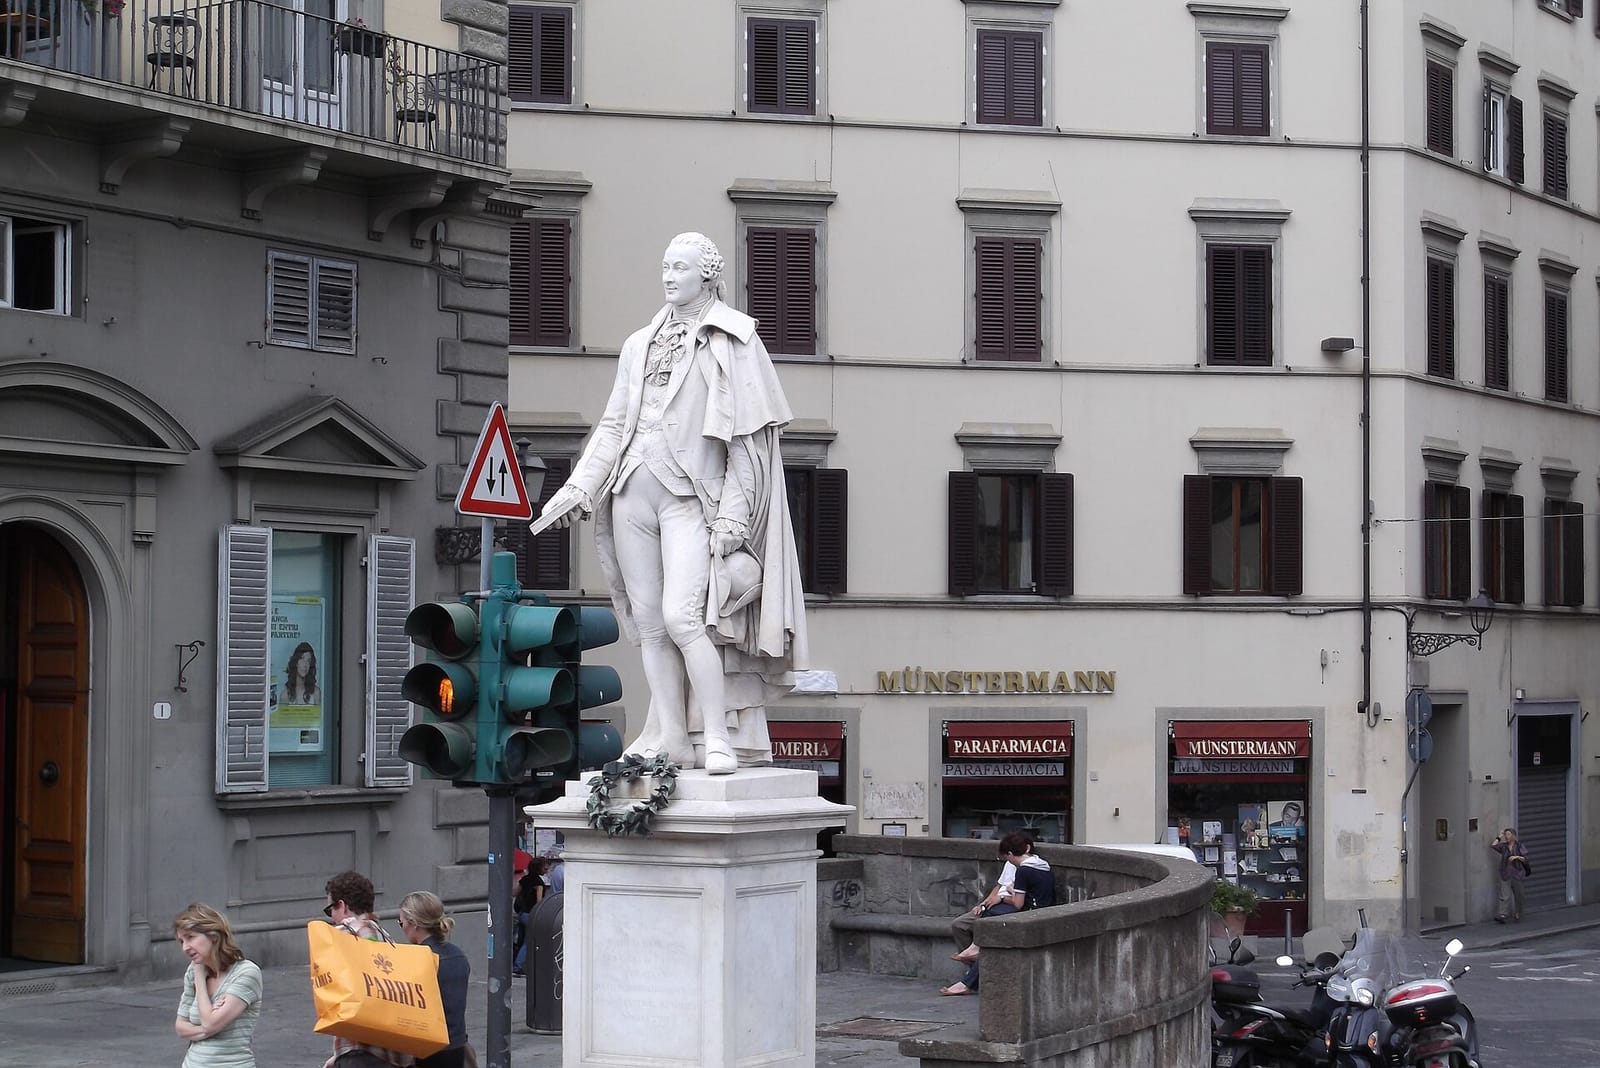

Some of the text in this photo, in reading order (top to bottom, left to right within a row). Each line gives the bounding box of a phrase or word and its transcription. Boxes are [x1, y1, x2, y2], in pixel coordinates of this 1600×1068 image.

[877, 665, 1117, 693] MÜNSTERMANN
[953, 739, 1067, 753] PARAFARMACIA
[945, 763, 1060, 776] PARAFARMACIA
[361, 971, 427, 1010] PARRIS
